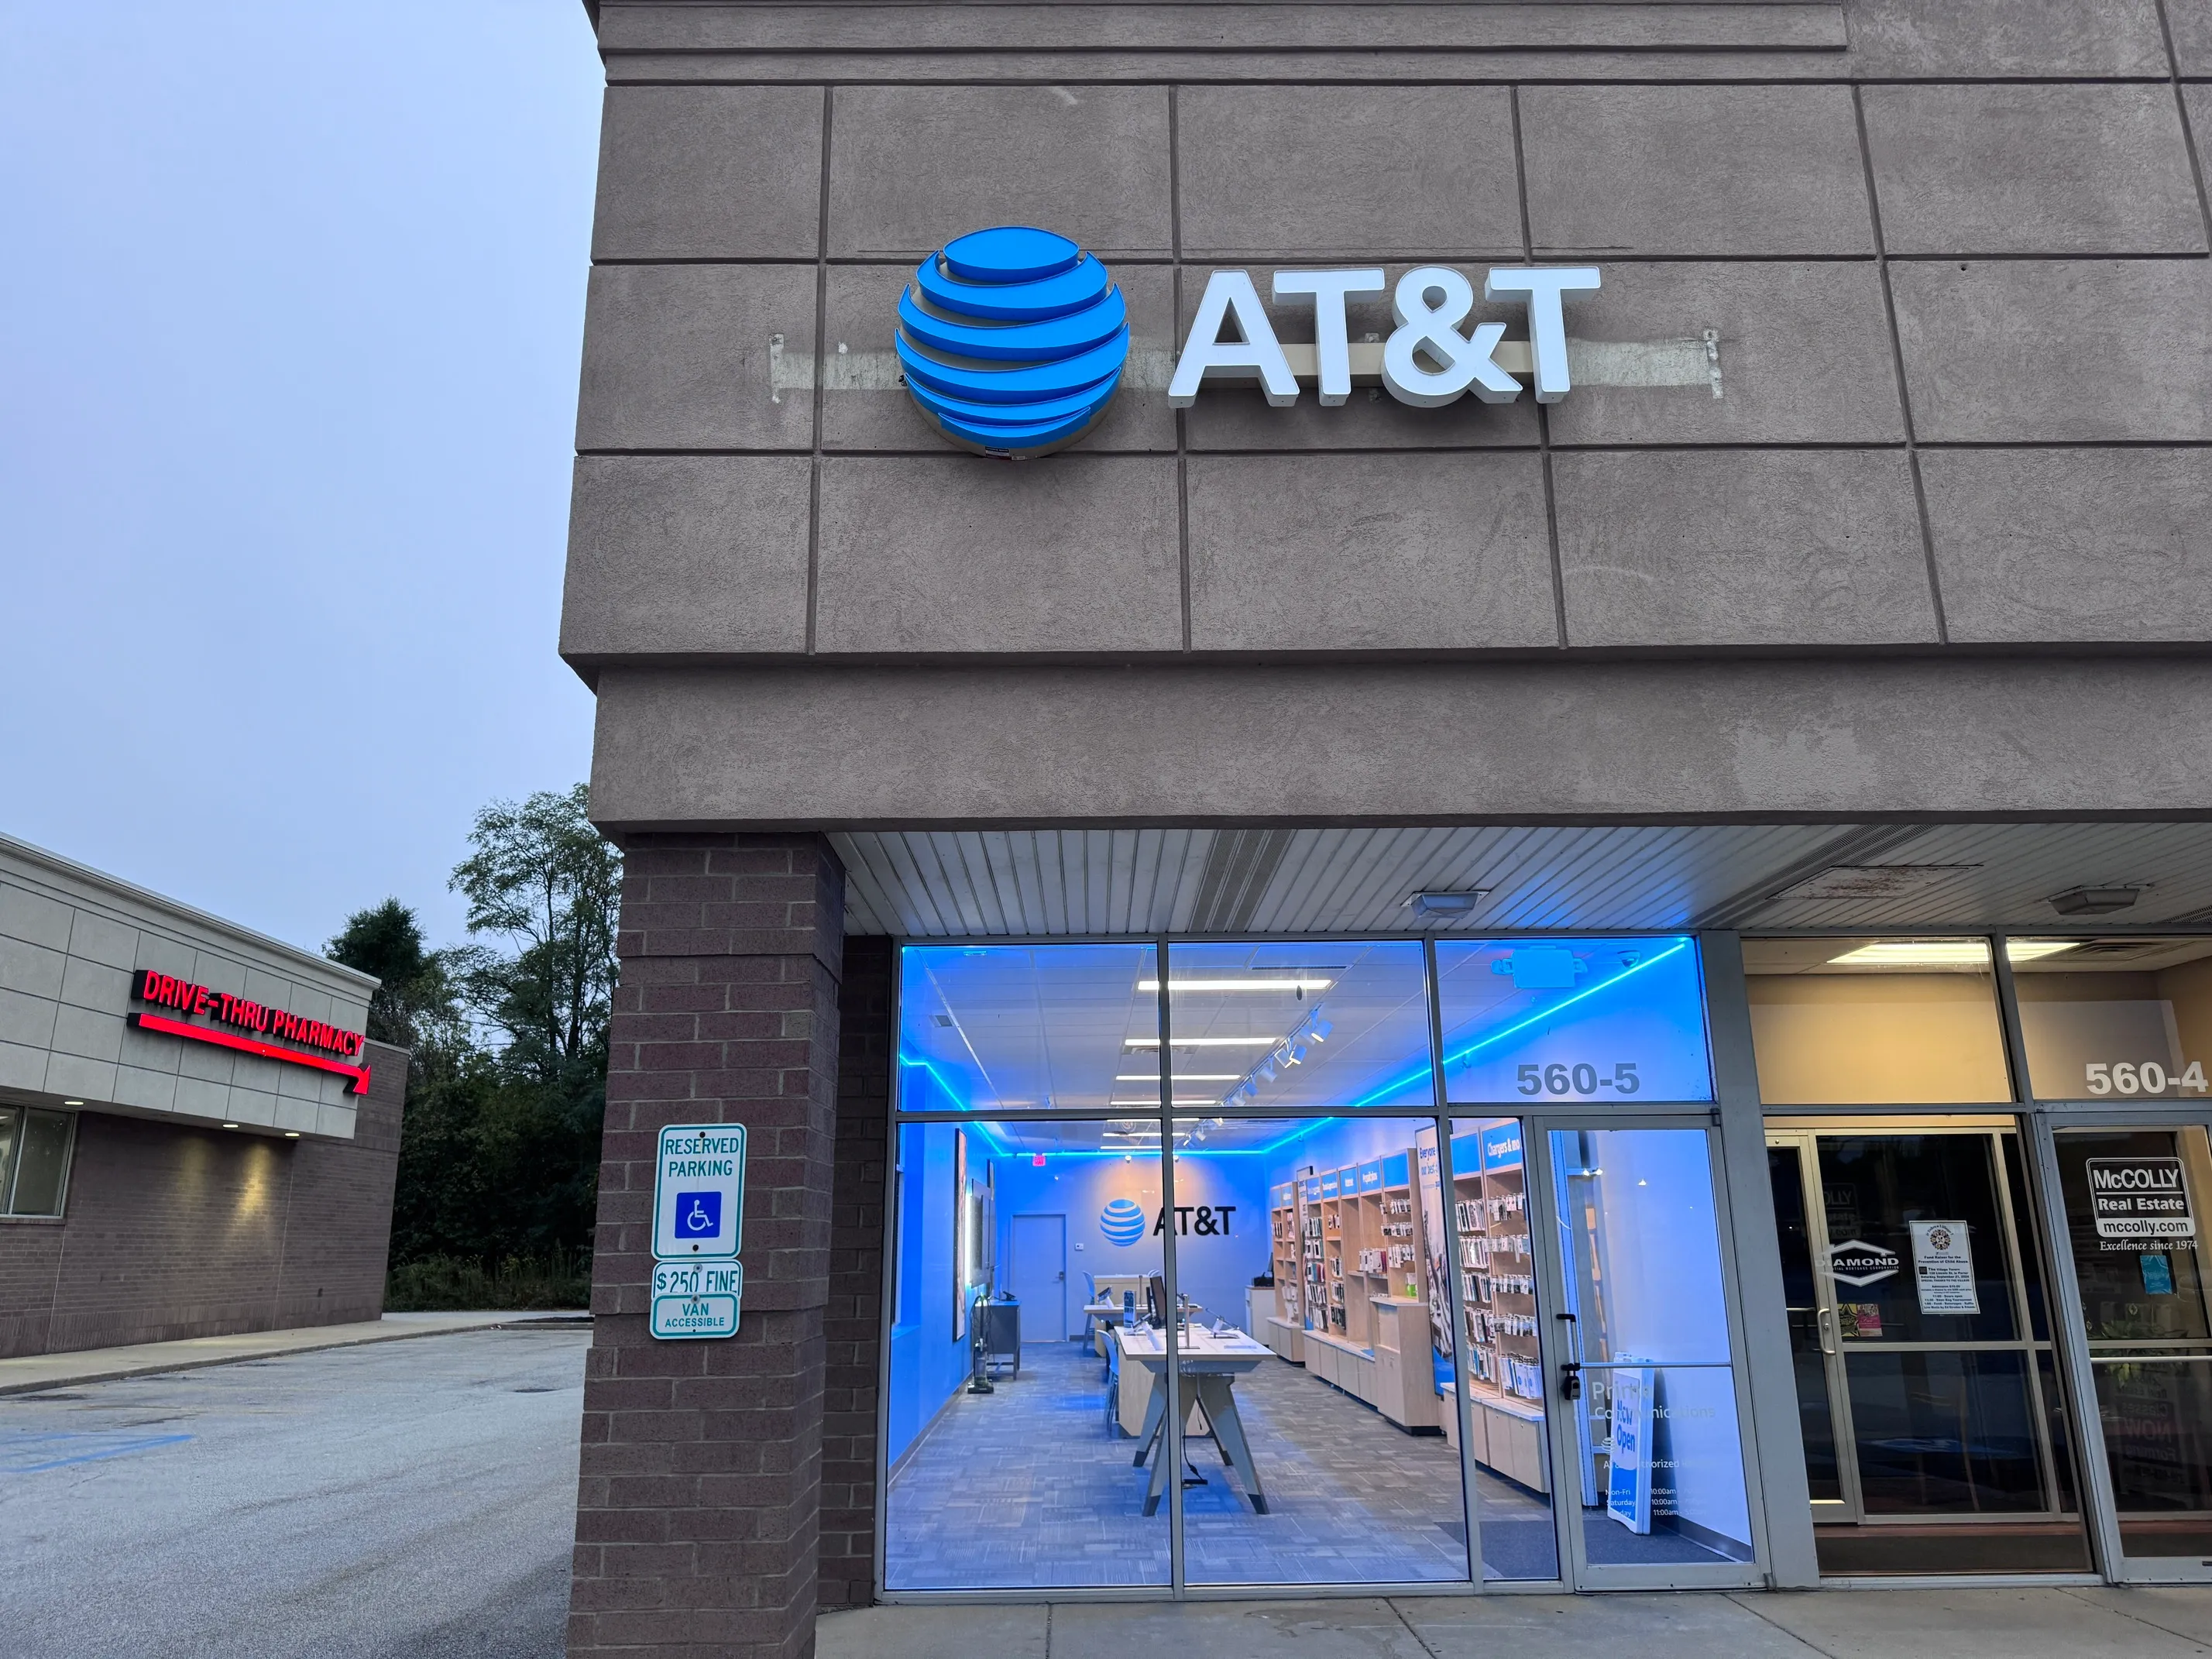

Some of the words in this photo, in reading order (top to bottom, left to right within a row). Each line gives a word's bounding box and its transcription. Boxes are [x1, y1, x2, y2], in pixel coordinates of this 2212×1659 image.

[1168, 266, 1601, 407] AT&T
[143, 970, 269, 1032] DRIVE-THRU
[273, 1009, 365, 1056] PHARMACY
[1516, 1063, 1640, 1095] 560-5
[2086, 1061, 2210, 1094] 560-4
[665, 1137, 739, 1155] RESERVED
[668, 1159, 733, 1177] PARKING
[2093, 1169, 2179, 1189] McCOLLY
[2097, 1198, 2132, 1211] Real
[2136, 1198, 2184, 1211] Estate
[1152, 1206, 1236, 1236] AT&T
[2104, 1220, 2188, 1235] mccolly.com
[2100, 1239, 2147, 1251] Excellence
[2150, 1240, 2173, 1250] since
[2176, 1240, 2198, 1250] 1974
[657, 1271, 699, 1293] $250
[706, 1270, 737, 1293] FINE
[682, 1303, 709, 1316] VAN
[665, 1317, 725, 1328] ACCESSIBLE
[1617, 1424, 1635, 1454] Open
